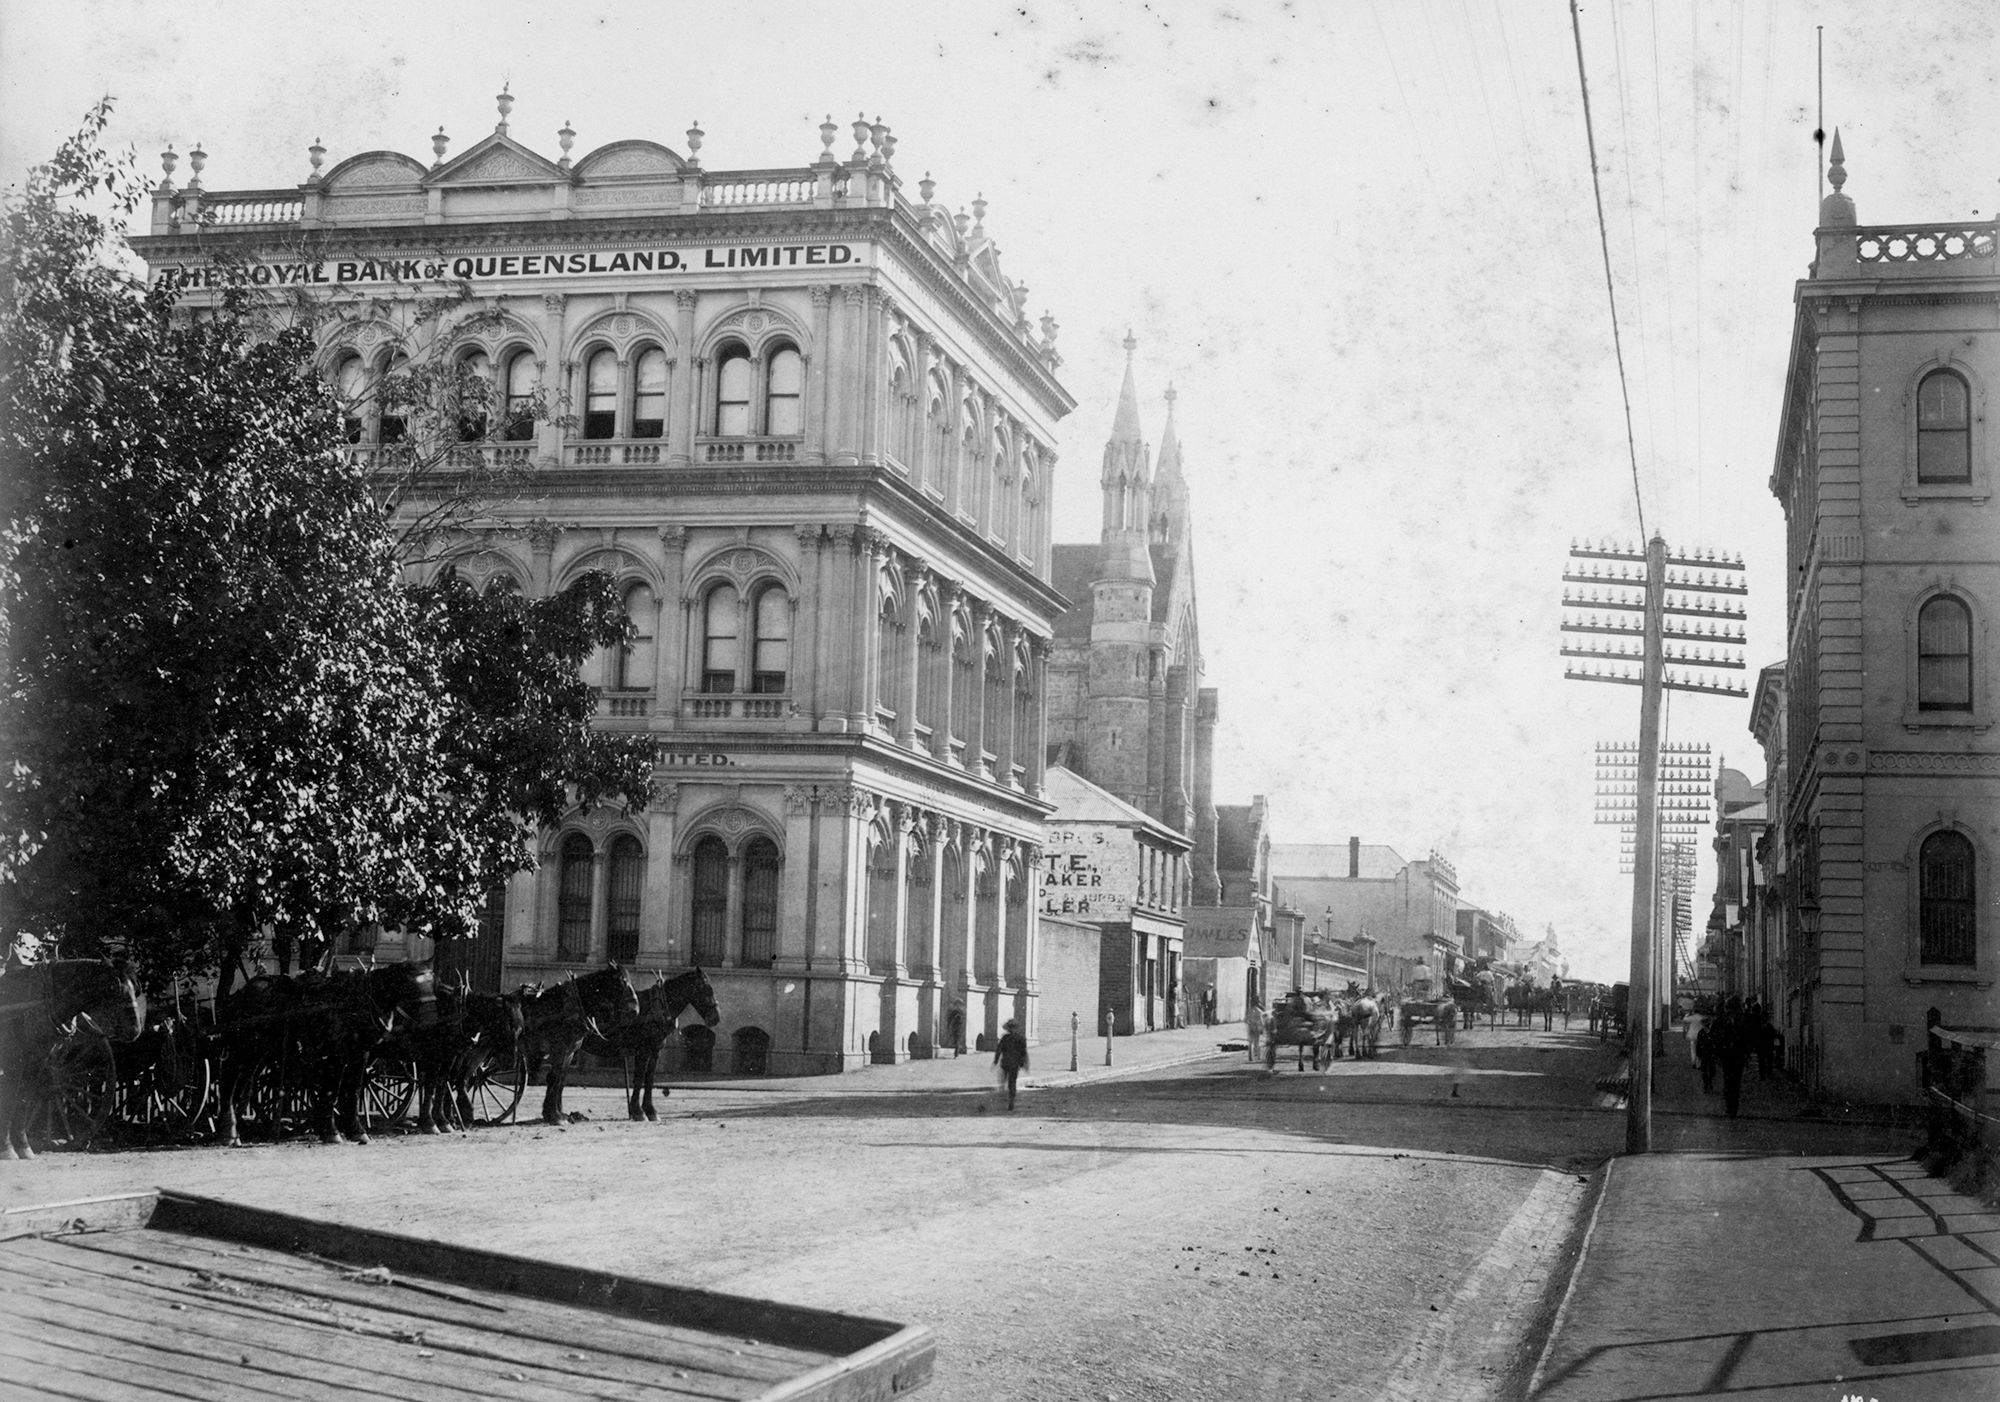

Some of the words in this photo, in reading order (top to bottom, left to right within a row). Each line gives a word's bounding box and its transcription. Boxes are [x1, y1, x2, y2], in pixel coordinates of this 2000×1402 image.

[161, 266, 223, 288] THE
[228, 263, 329, 286] ROYAL
[337, 260, 421, 282] BANK
[453, 250, 687, 278] QUEENSLAND,
[704, 244, 861, 268] LIMITED.
[1039, 873, 1102, 887] AKER
[1039, 899, 1091, 914] LER
